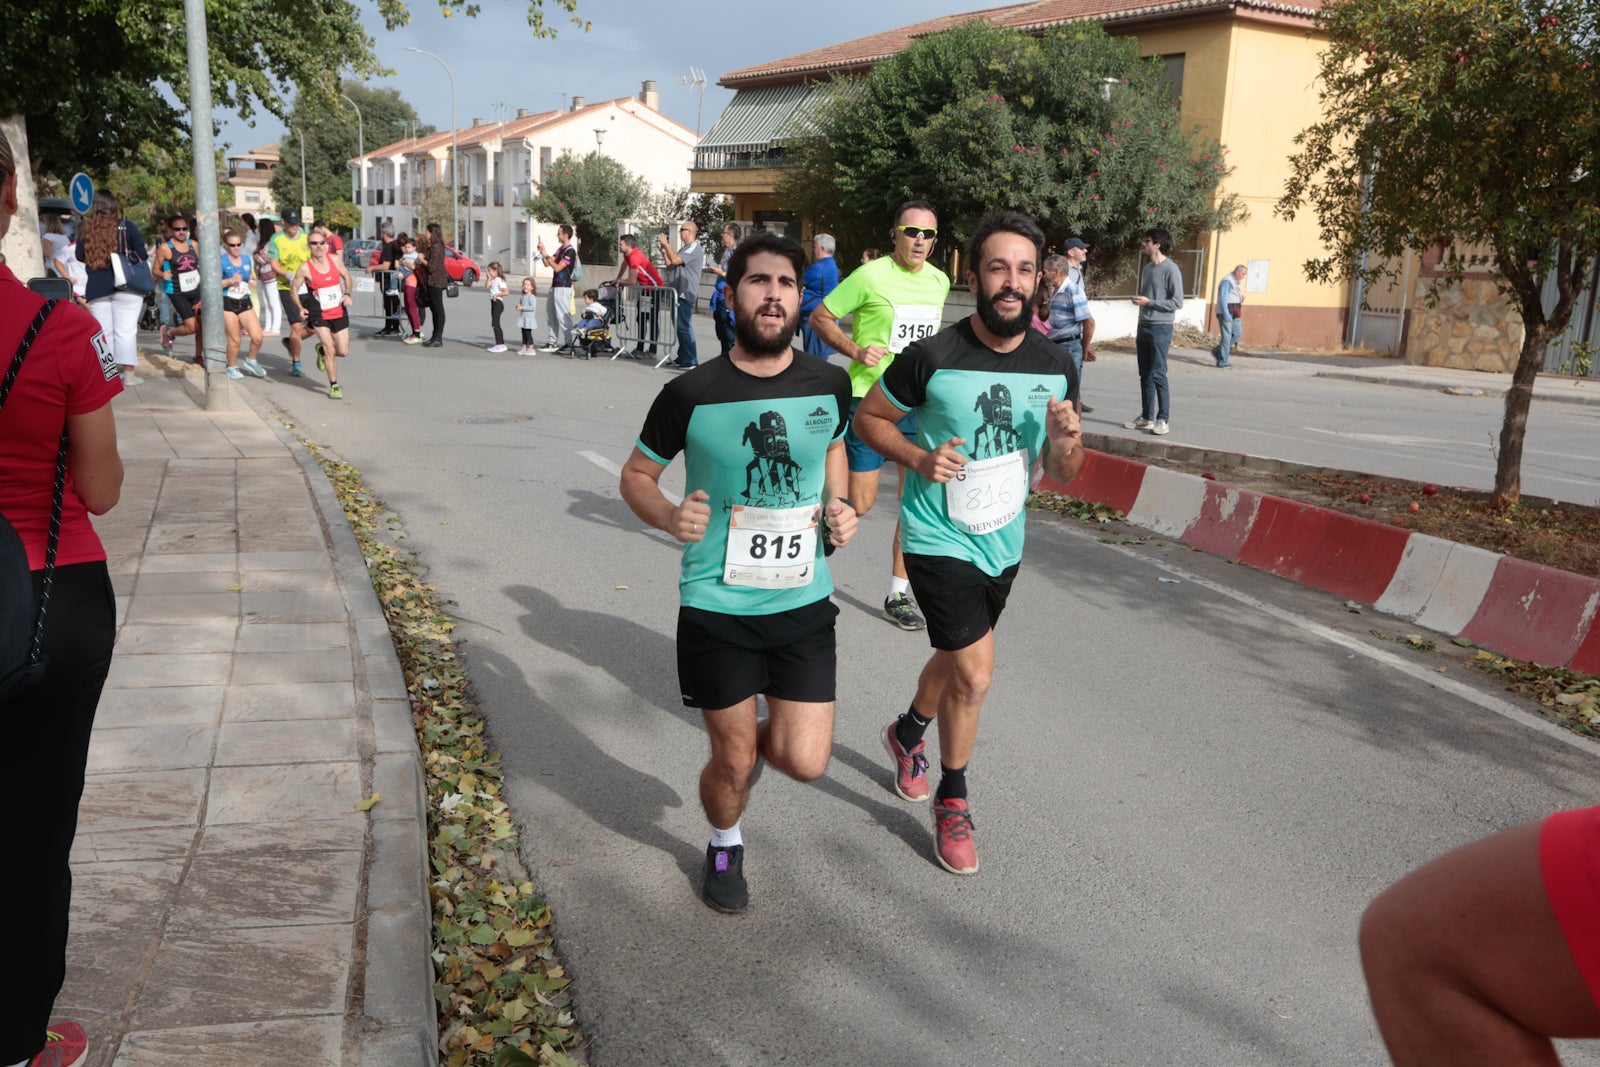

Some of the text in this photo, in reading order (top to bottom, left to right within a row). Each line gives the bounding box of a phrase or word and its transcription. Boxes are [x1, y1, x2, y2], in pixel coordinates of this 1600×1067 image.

[327, 293, 337, 301] 39
[897, 323, 934, 339] 3150
[96, 339, 105, 354] I
[805, 417, 833, 426] ALBOLOTE
[965, 478, 1013, 511] 816
[749, 533, 803, 560] 815
